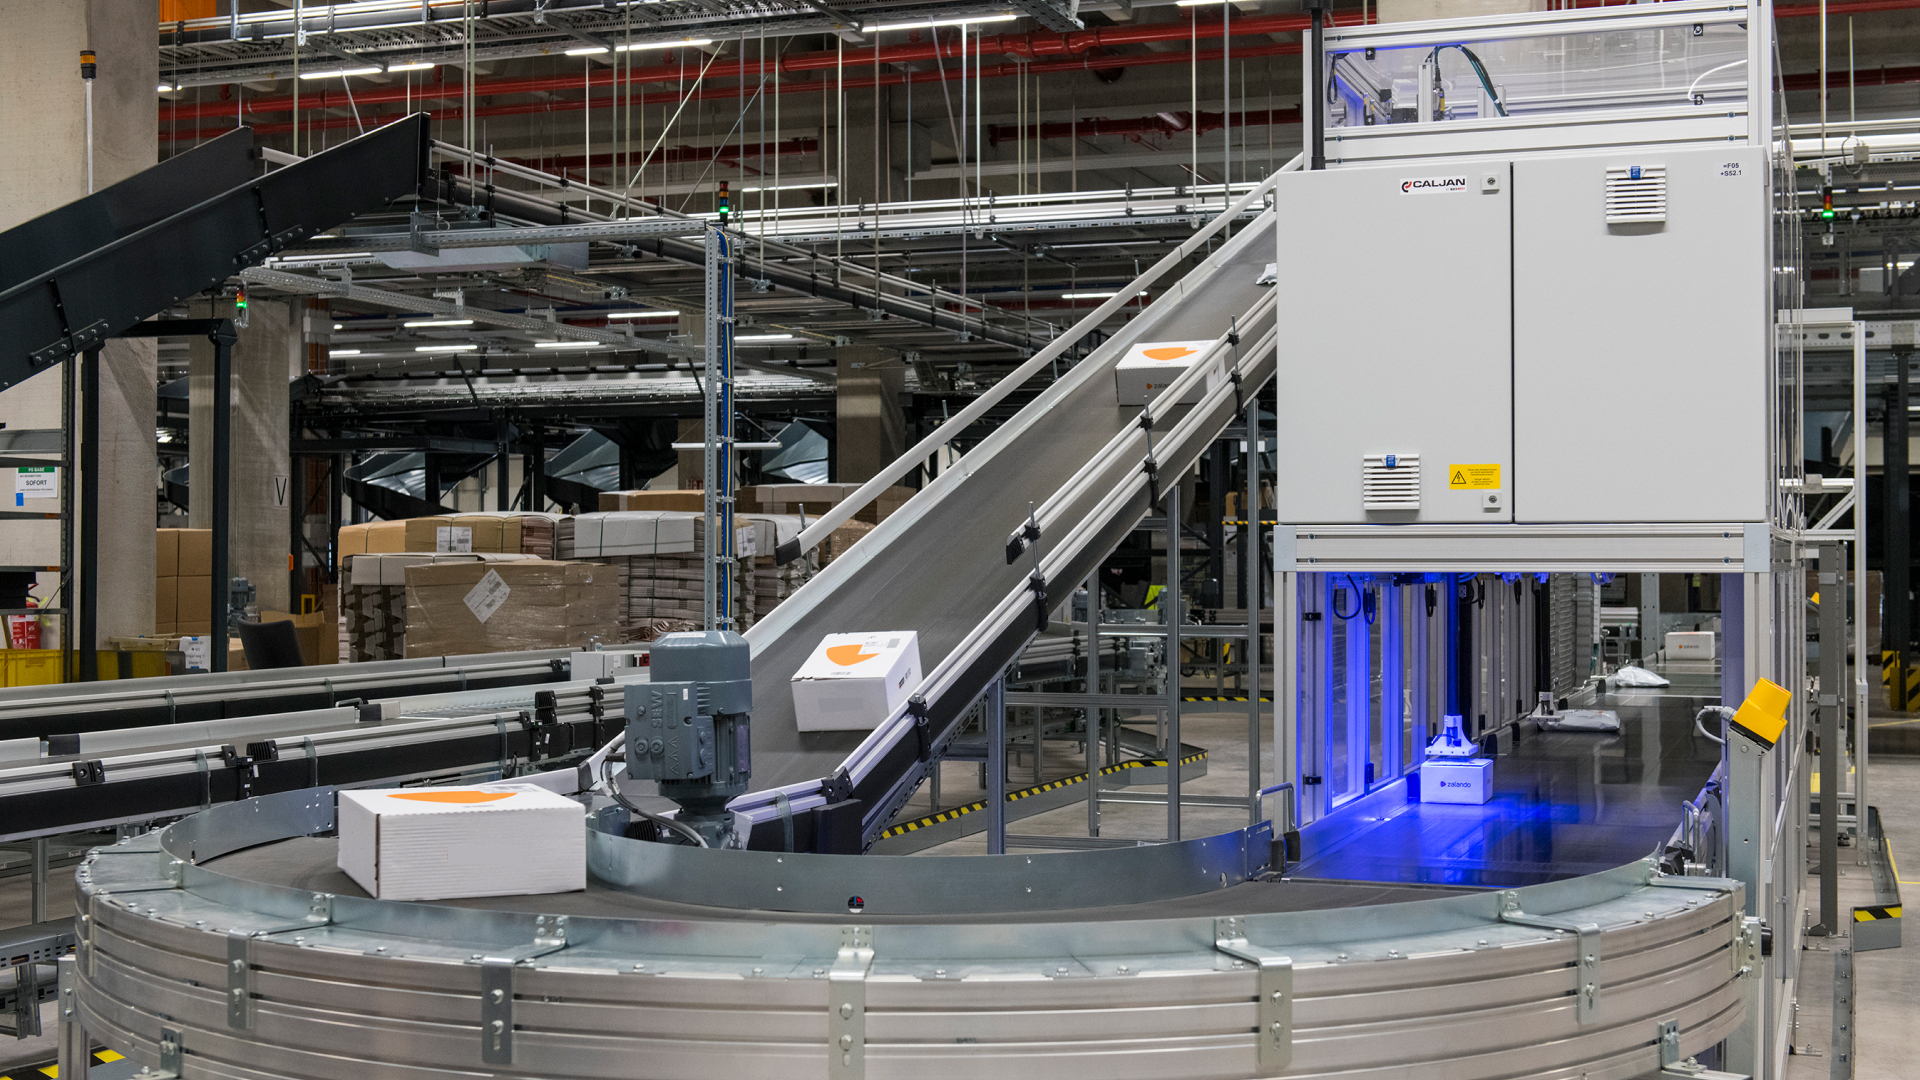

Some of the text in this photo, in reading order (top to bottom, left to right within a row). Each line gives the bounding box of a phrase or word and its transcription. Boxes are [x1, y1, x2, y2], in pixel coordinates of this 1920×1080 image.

[1413, 178, 1466, 188] CALJAN
[275, 477, 288, 505] V
[651, 690, 663, 729] SEW
